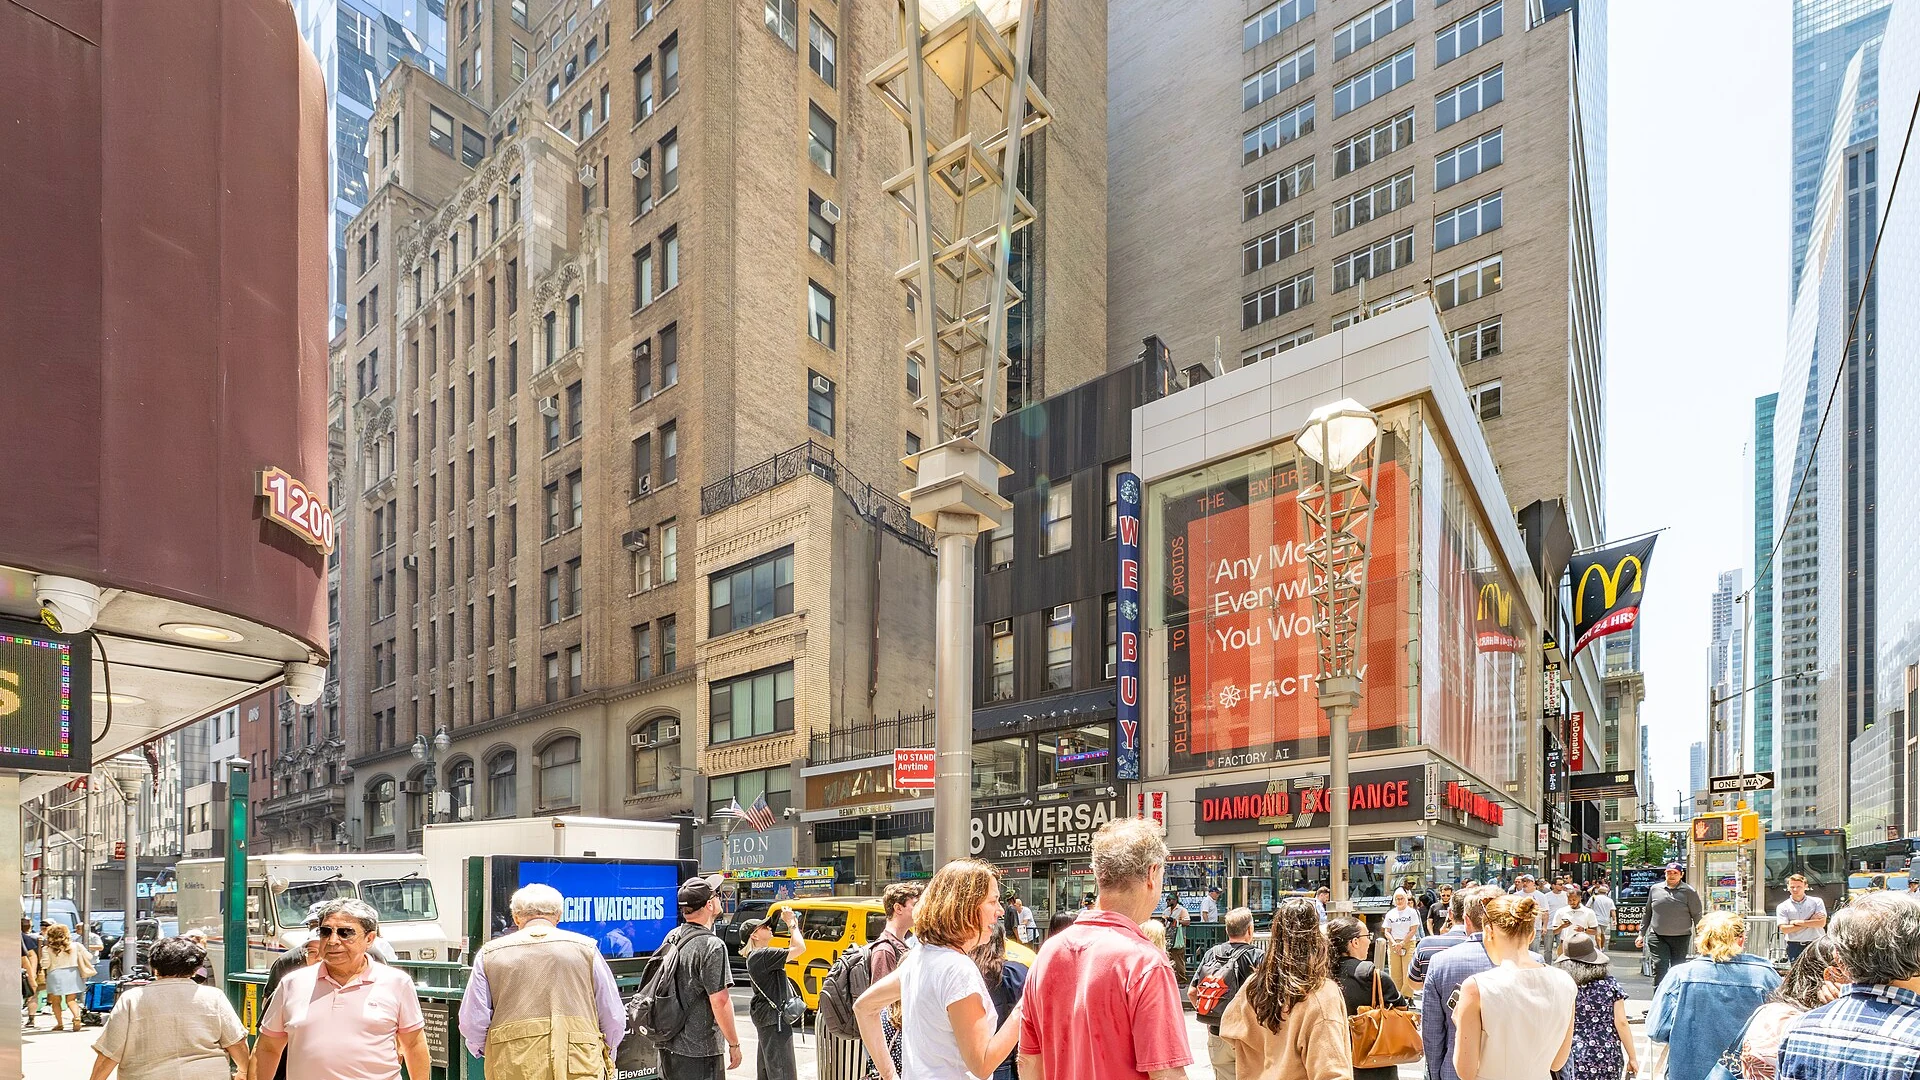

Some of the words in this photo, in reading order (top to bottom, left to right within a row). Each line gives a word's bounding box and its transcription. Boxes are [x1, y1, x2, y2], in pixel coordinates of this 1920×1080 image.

[1197, 491, 1225, 513] THE
[1249, 465, 1309, 497] ENTIRE
[270, 477, 332, 548] 1200
[1120, 515, 1139, 592] WE
[1172, 535, 1185, 596] DROIDS
[1215, 554, 1263, 585] Any
[1174, 629, 1186, 651] TO
[1216, 626, 1261, 652] You
[1594, 620, 1608, 634] 24
[1120, 631, 1138, 750] BUY
[1250, 664, 1368, 702] FACTY
[1175, 674, 1187, 753] DELEGATE
[1572, 714, 1581, 761] McDonald's
[897, 753, 908, 762] NO
[897, 763, 929, 772] Anytime
[1218, 748, 1290, 768] FACTORY.AI
[1718, 780, 1737, 788] ONE
[1745, 778, 1764, 786] WAY
[1203, 791, 1289, 822] DIAMOND
[1301, 780, 1409, 814] EXCANGE
[733, 835, 769, 854] EON
[1000, 848, 1042, 858] MILSONS
[752, 881, 774, 889] BREAKFAST
[594, 896, 664, 922] WATCHERS
[618, 1066, 657, 1080] Elevator
